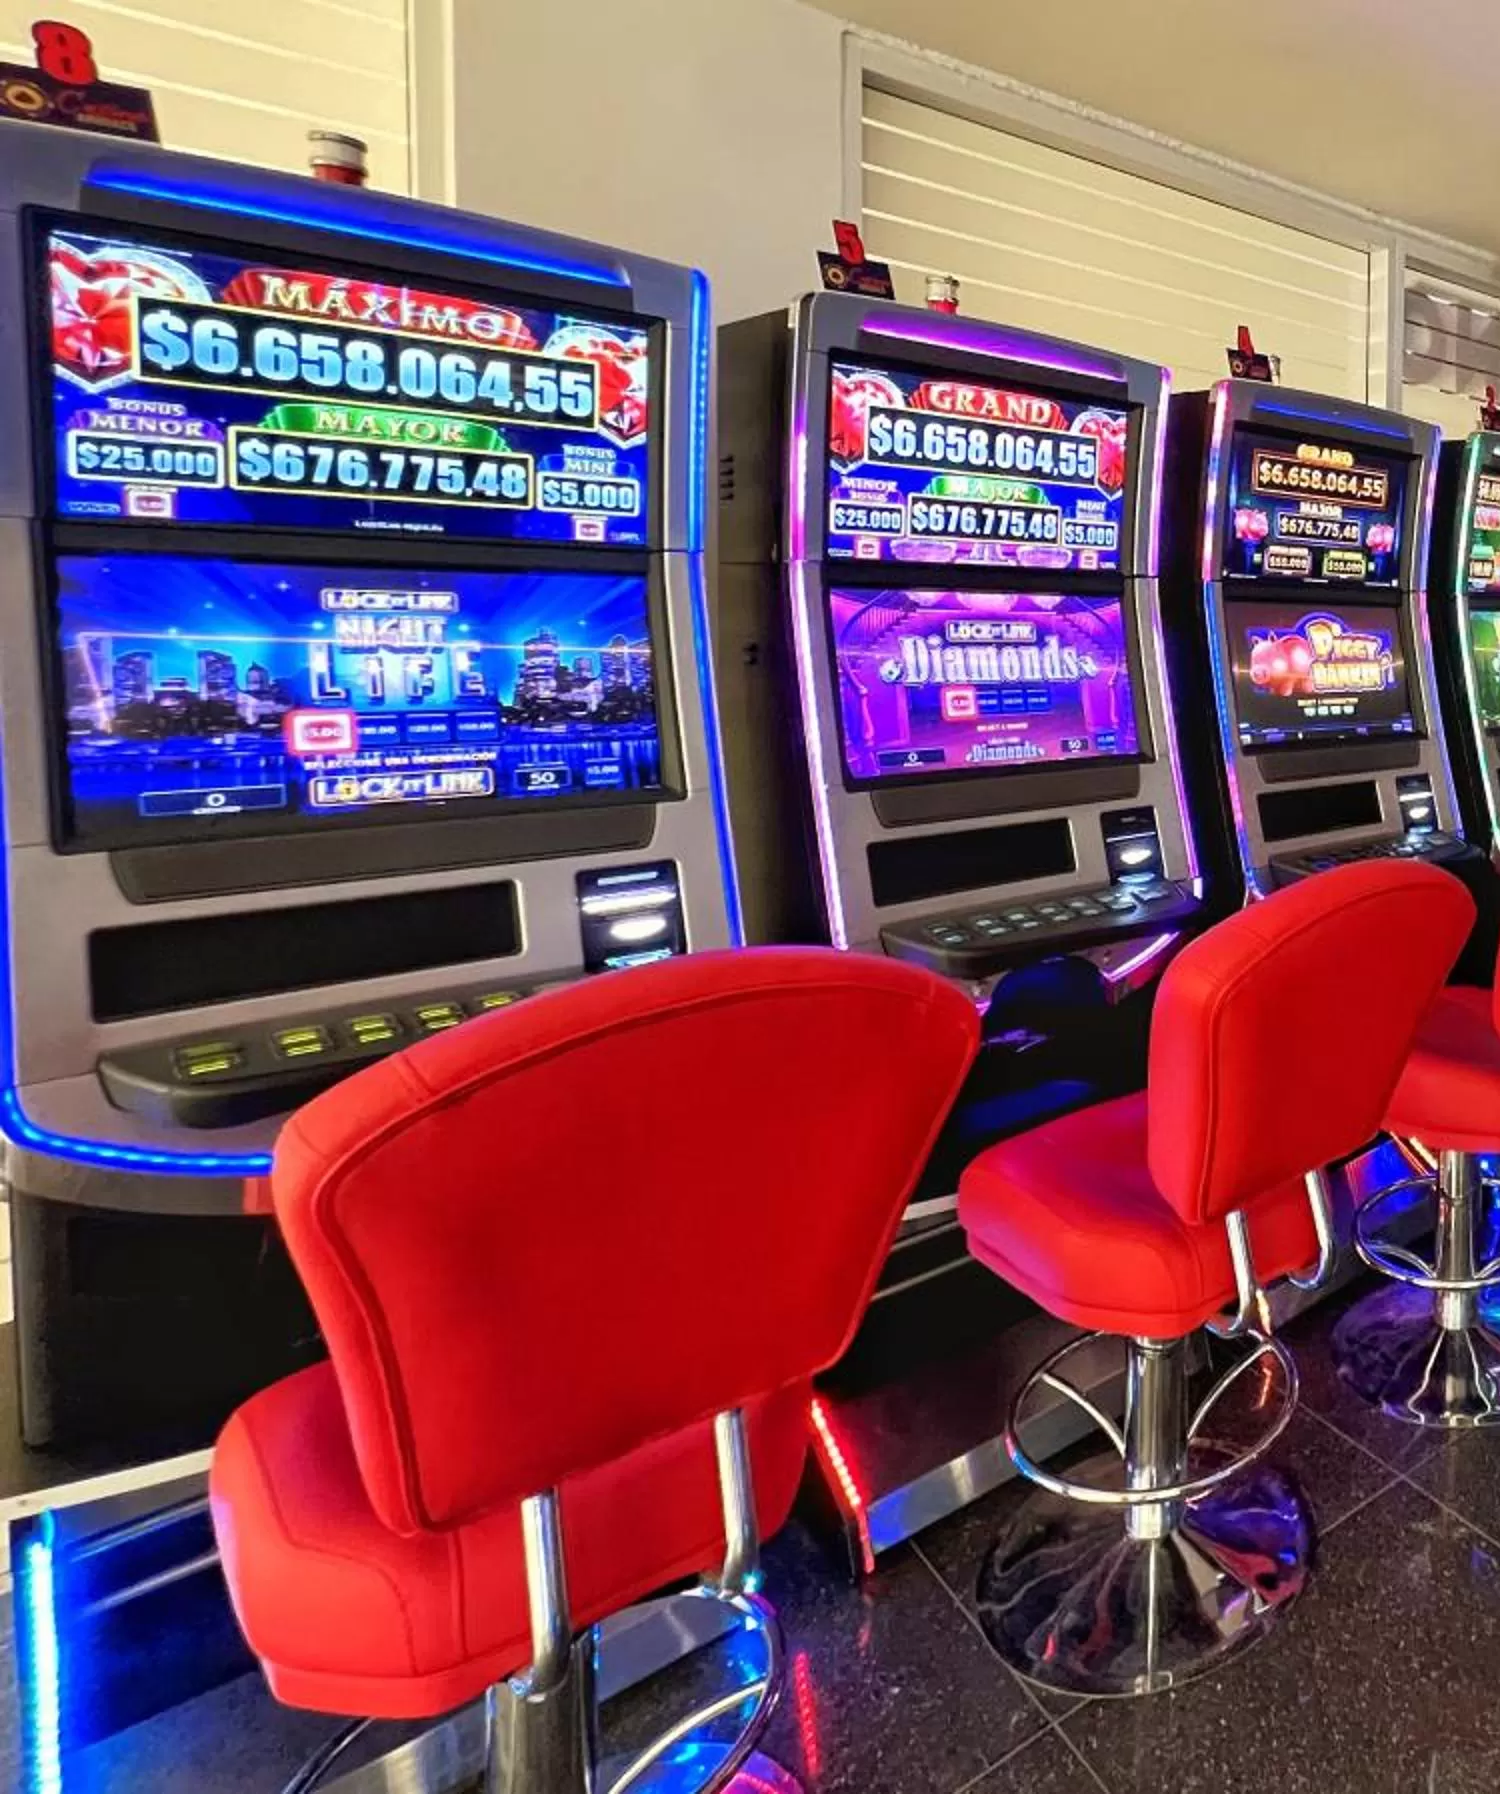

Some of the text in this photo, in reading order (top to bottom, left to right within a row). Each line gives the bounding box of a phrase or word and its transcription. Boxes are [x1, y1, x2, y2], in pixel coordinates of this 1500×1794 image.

[31, 20, 99, 85] 8
[832, 220, 865, 264] 5
[262, 274, 505, 339] MÁXIMO
[141, 309, 594, 416] $6.658.064,55
[106, 397, 187, 417] BONUS
[929, 384, 1050, 423] GRAND
[89, 411, 205, 437] MENOR
[316, 408, 470, 444] MAYOR
[77, 442, 216, 477] $25.000
[868, 413, 1096, 479] $6.658.064,55
[1297, 444, 1354, 467] GRAND
[238, 438, 528, 500] $676.775,48
[564, 459, 616, 475] MINI
[1259, 461, 1383, 498] $6.658.064,55
[543, 480, 635, 509] $5.000
[835, 507, 901, 529] $25.000
[911, 501, 1057, 540] $676.775,48
[1064, 525, 1114, 545] $5.000
[334, 614, 448, 652] NIGHT
[308, 640, 487, 701] LIFE
[898, 634, 1080, 687] Diamonds
[206, 793, 226, 807] 0
[317, 774, 402, 803] LOCK
